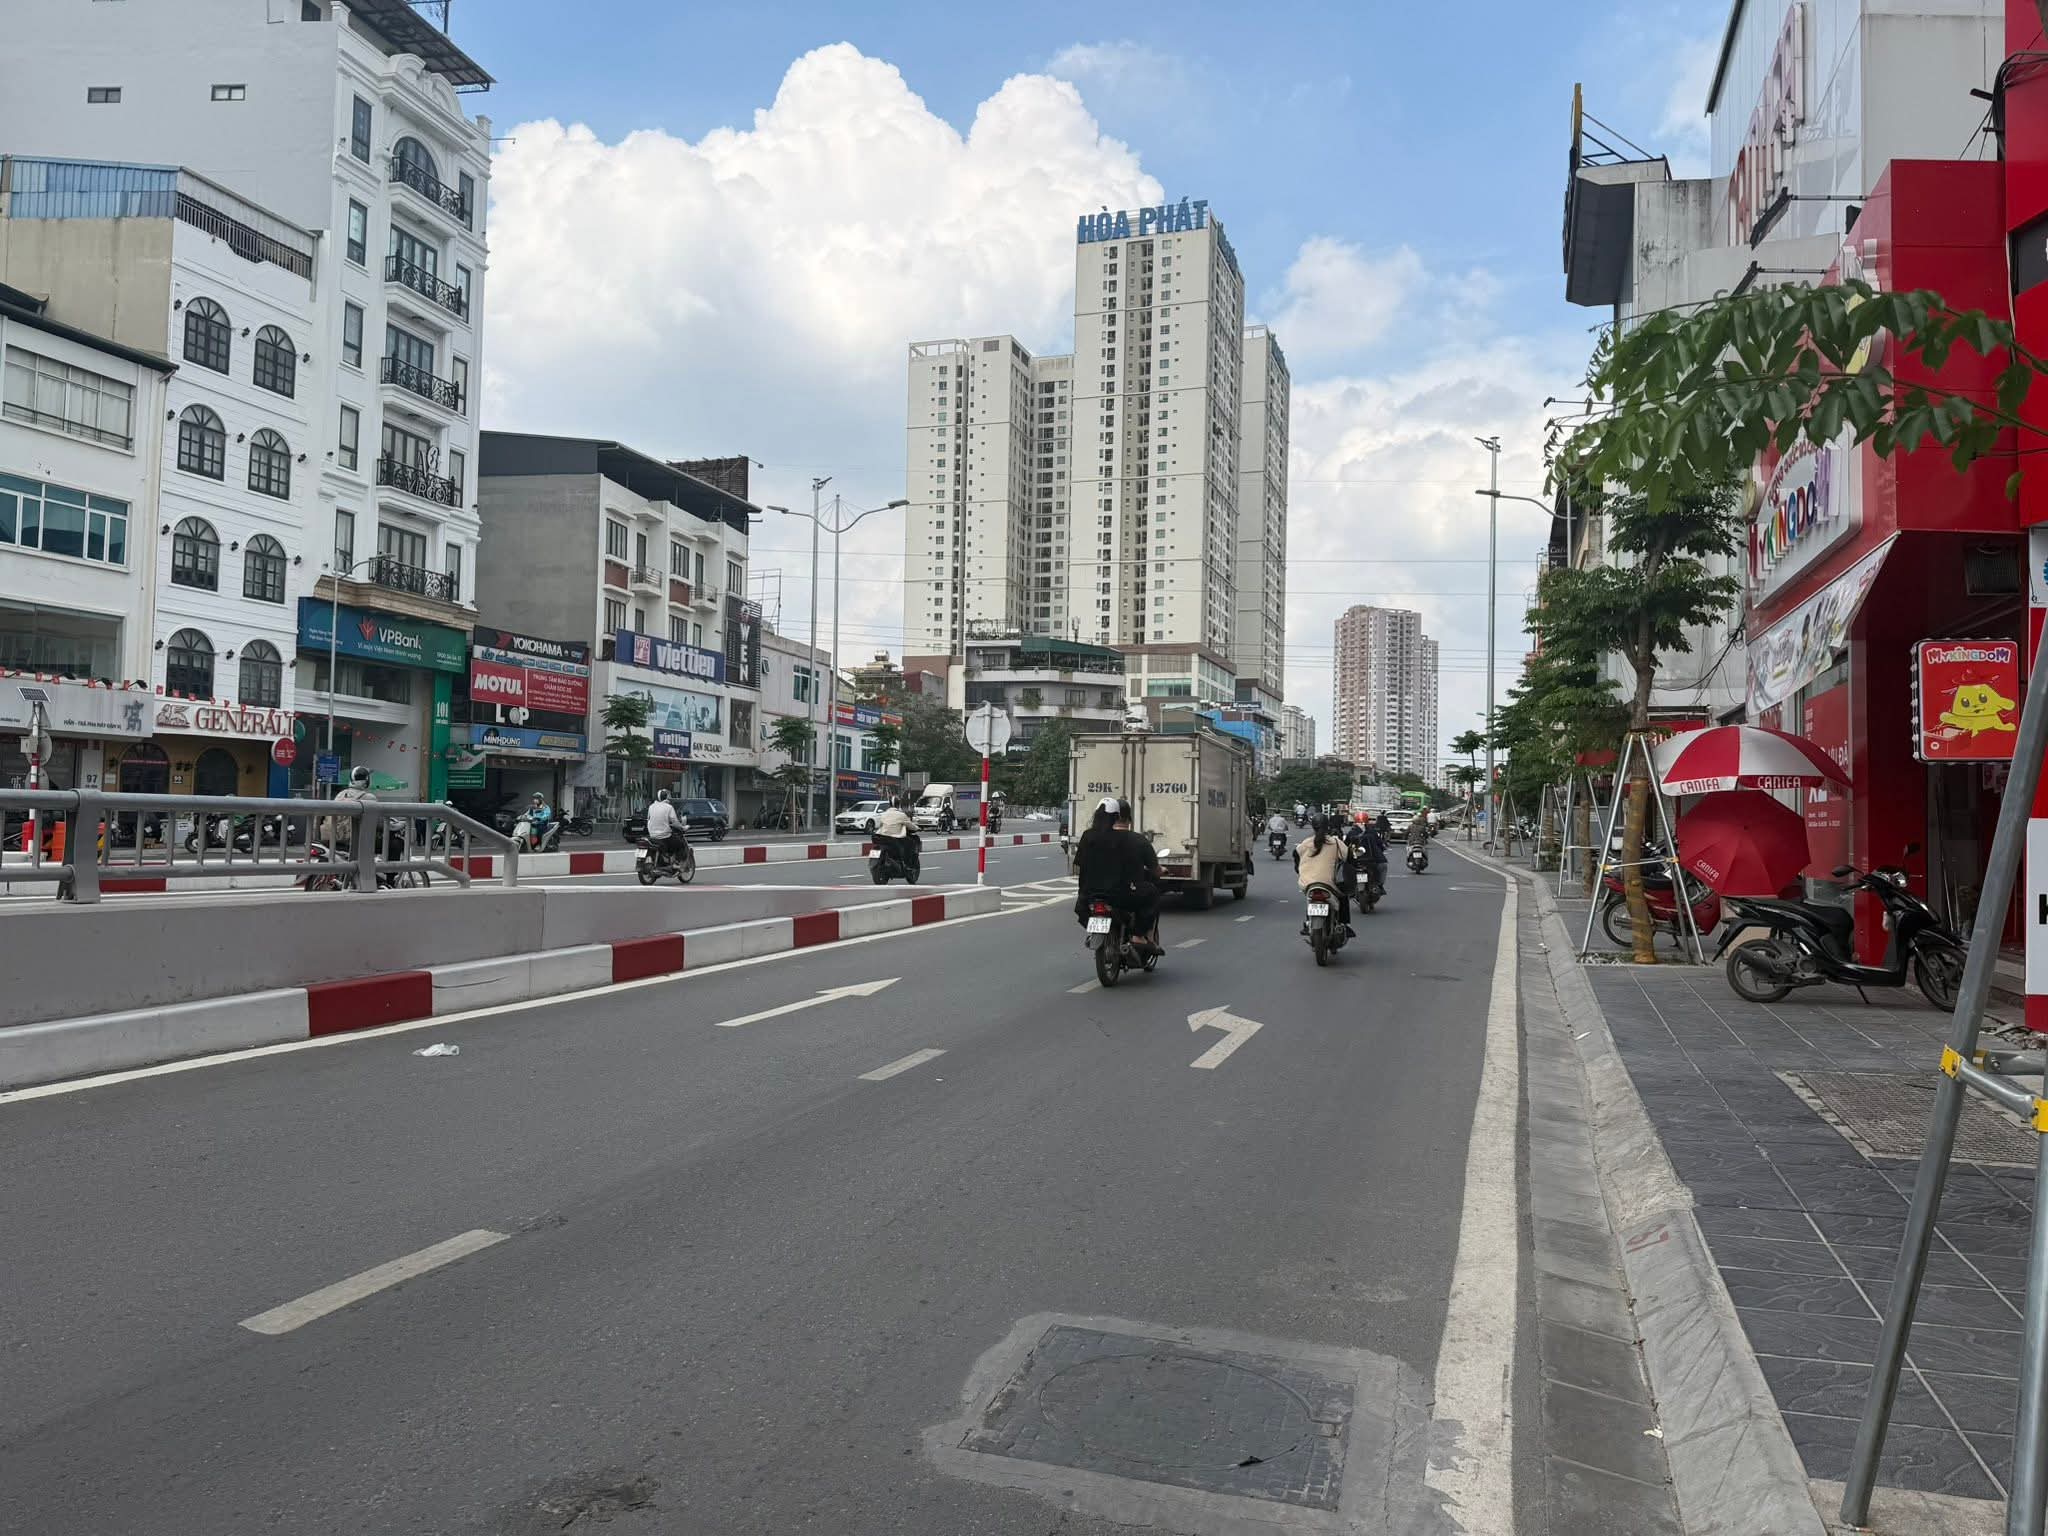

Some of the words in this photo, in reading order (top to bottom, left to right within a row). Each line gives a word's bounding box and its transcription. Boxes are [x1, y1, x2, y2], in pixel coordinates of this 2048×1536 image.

[1078, 205, 1131, 244] HÒA
[1139, 196, 1208, 237] PHÁT
[378, 627, 422, 650] VPBank
[513, 636, 563, 657] YOKOHAMA
[656, 643, 716, 678] viettien
[1926, 647, 2011, 664] MYKINGDOM
[474, 673, 523, 695] MOTUL
[436, 702, 448, 718] 101
[1680, 778, 1720, 794] CANIFA
[1757, 776, 1801, 790] CANIFA
[1697, 859, 1720, 880] CANIFA
